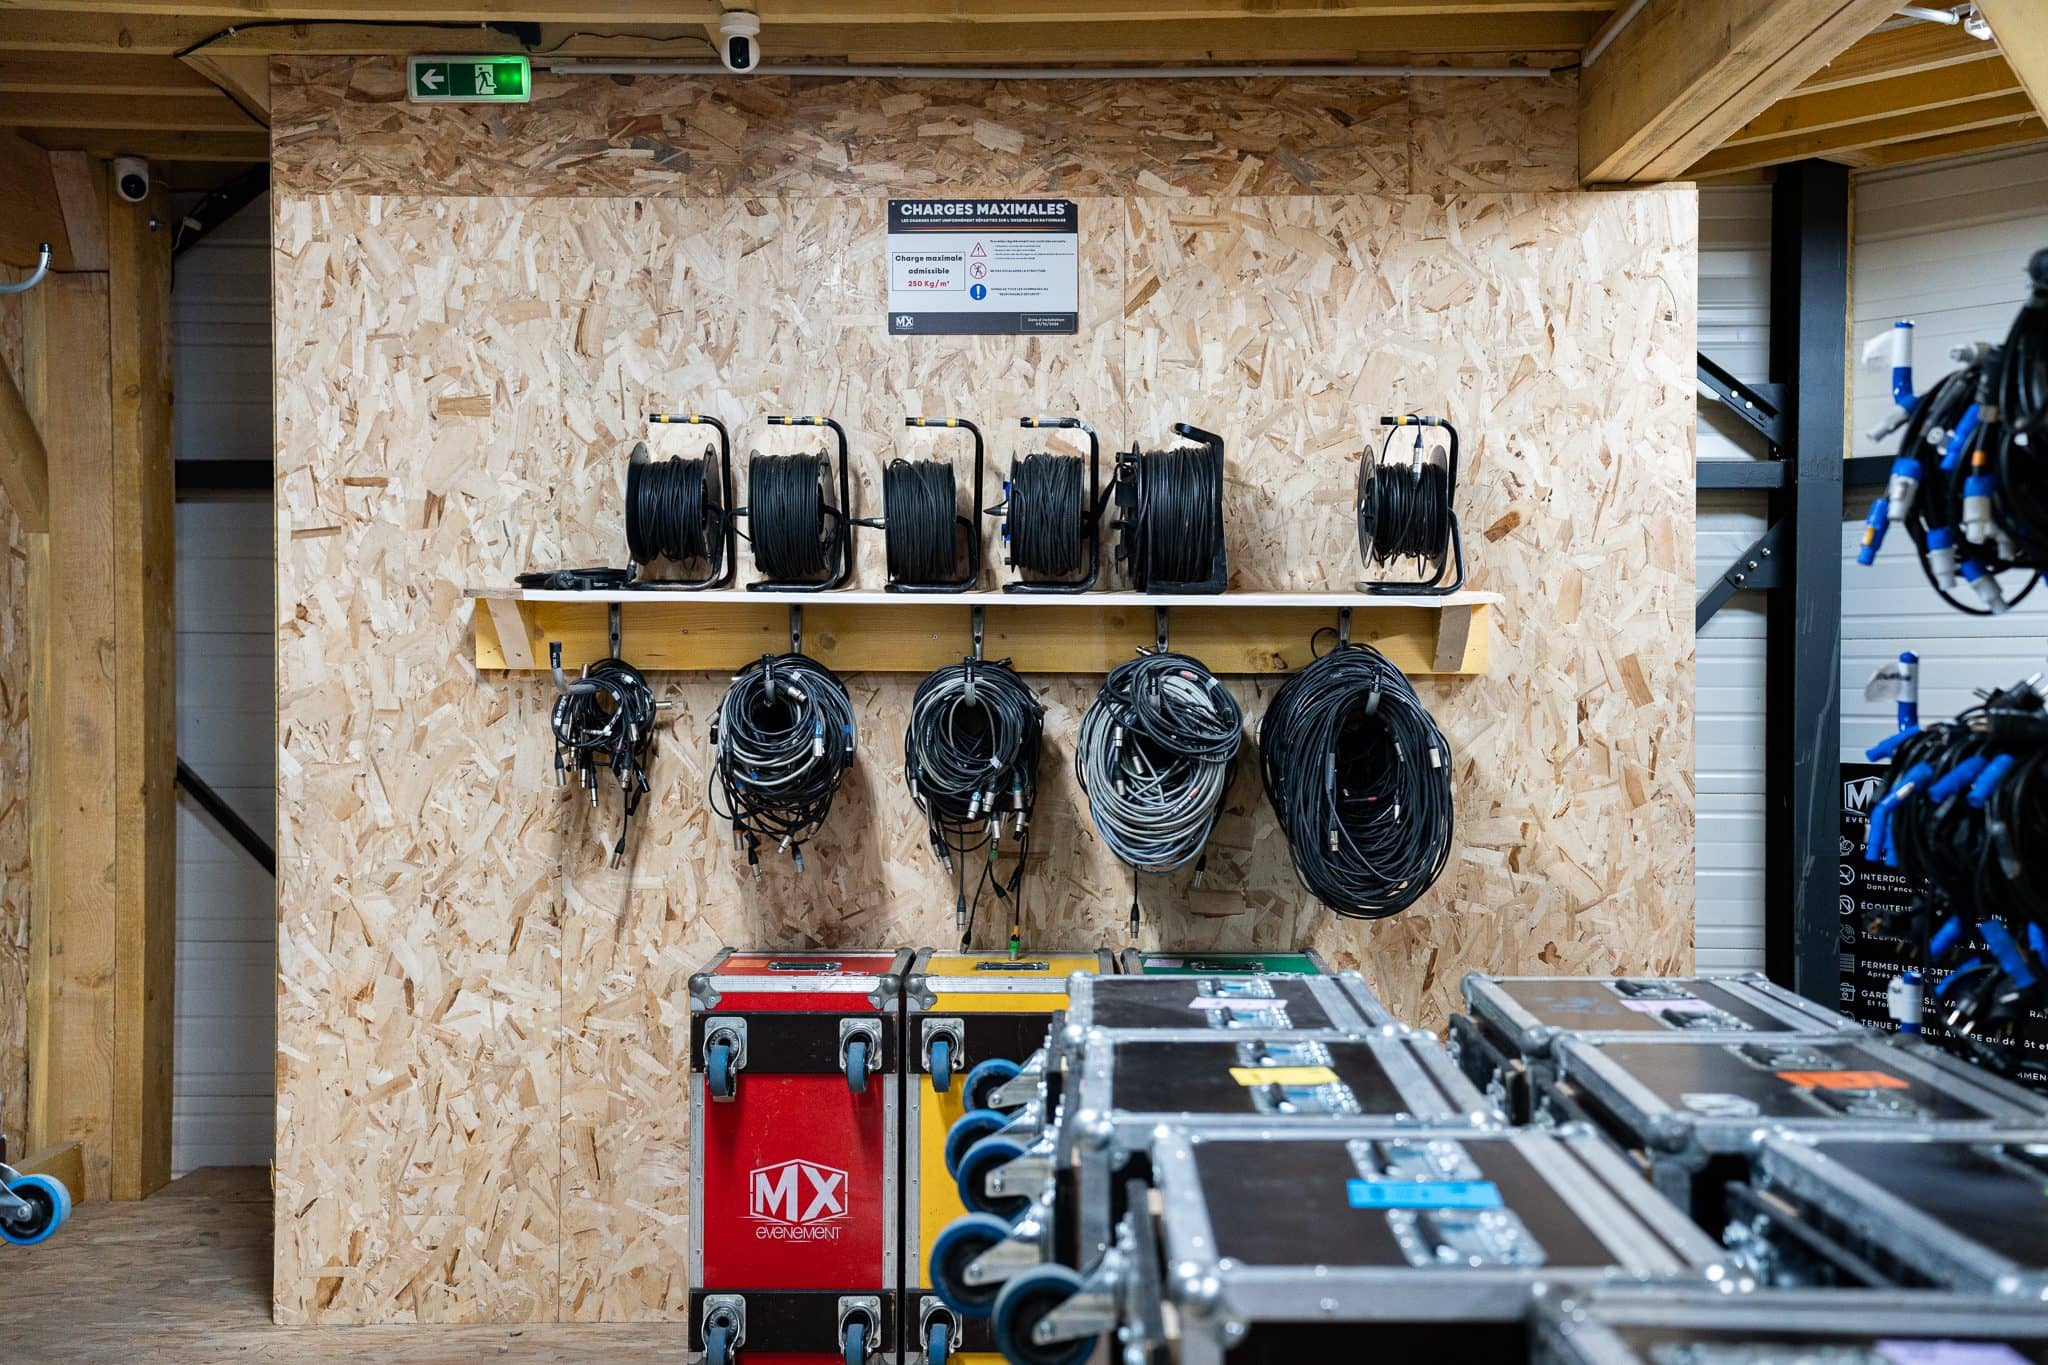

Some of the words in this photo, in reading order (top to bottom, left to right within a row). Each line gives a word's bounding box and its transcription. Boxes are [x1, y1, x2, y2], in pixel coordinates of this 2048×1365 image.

[901, 203, 974, 216] CHARGES
[976, 203, 1065, 216] MAXIMALES
[895, 255, 924, 263] Charge
[1847, 779, 1880, 811] M
[1866, 883, 1886, 891] Dans
[1861, 960, 1899, 971] FERMER
[1901, 965, 1919, 974] LES
[1867, 970, 1890, 979] Après
[1861, 1019, 1892, 1031] TENUE
[756, 1164, 843, 1222] MX
